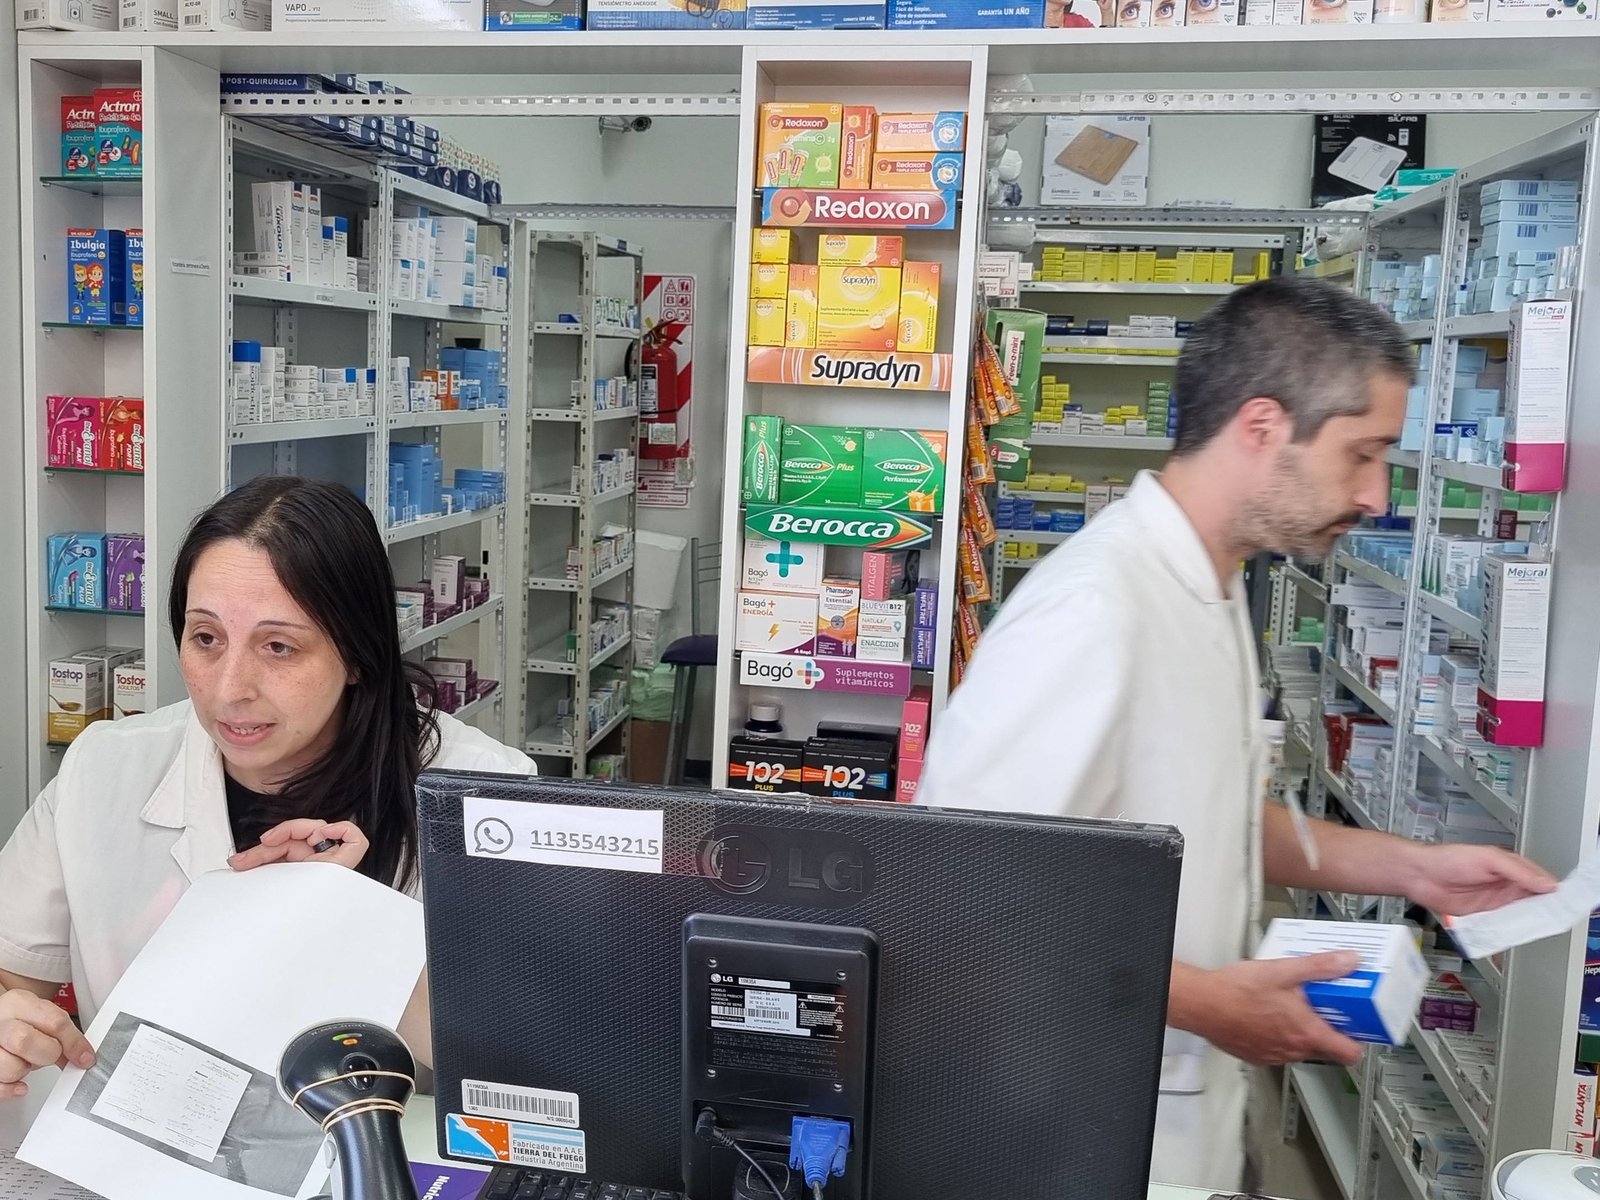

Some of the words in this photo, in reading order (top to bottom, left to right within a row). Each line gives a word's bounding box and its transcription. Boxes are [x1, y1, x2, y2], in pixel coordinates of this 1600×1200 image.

[153, 10, 174, 19] SMALL
[1015, 7, 1030, 15] AÑO
[226, 77, 299, 86] POST-QUIRURGICA
[99, 101, 140, 112] Actron
[785, 119, 824, 127] Redoxon
[98, 126, 130, 136] Ibuprofeno
[846, 135, 854, 165] Redoxon
[815, 196, 930, 220] Redoxon
[71, 240, 106, 251] Ibulgia
[843, 276, 876, 286] Supradyn
[1527, 305, 1567, 317] Mejoral
[812, 355, 921, 388] Supradyn
[759, 421, 767, 439] Plus
[991, 446, 997, 456] 6
[756, 452, 765, 490] Berocca
[785, 461, 822, 469] Berocca
[836, 463, 855, 471] Plus
[883, 462, 921, 471] Berocca
[883, 476, 923, 484] Performance
[768, 513, 894, 539] Berocca
[965, 528, 981, 573] Redoxitos
[748, 567, 769, 578] Bagó
[867, 555, 877, 598] VITALGEN
[1507, 567, 1549, 578] Mejoral
[743, 598, 766, 609] Bagó
[743, 608, 774, 617] ENERGÍA
[51, 668, 83, 683] Tostop
[748, 660, 793, 682] Bagó
[836, 668, 894, 680] Suplementos
[835, 676, 894, 688] vitamínicos
[904, 723, 922, 734] 102
[745, 761, 786, 785] 102
[823, 766, 867, 790] 102
[754, 784, 775, 792] PLUS
[900, 780, 917, 790] 102
[832, 790, 854, 798] PLUS
[530, 829, 660, 857] 1135543215
[787, 851, 864, 893] LG
[722, 975, 734, 983] LG
[1574, 1083, 1587, 1127] MYLANTA
[513, 1140, 550, 1152] Fabricado
[513, 1147, 540, 1157] TIERRA
[542, 1151, 557, 1159] DEL
[560, 1154, 584, 1163] FUEGO
[513, 1155, 547, 1165] Industria
[548, 1159, 584, 1170] Argentina
